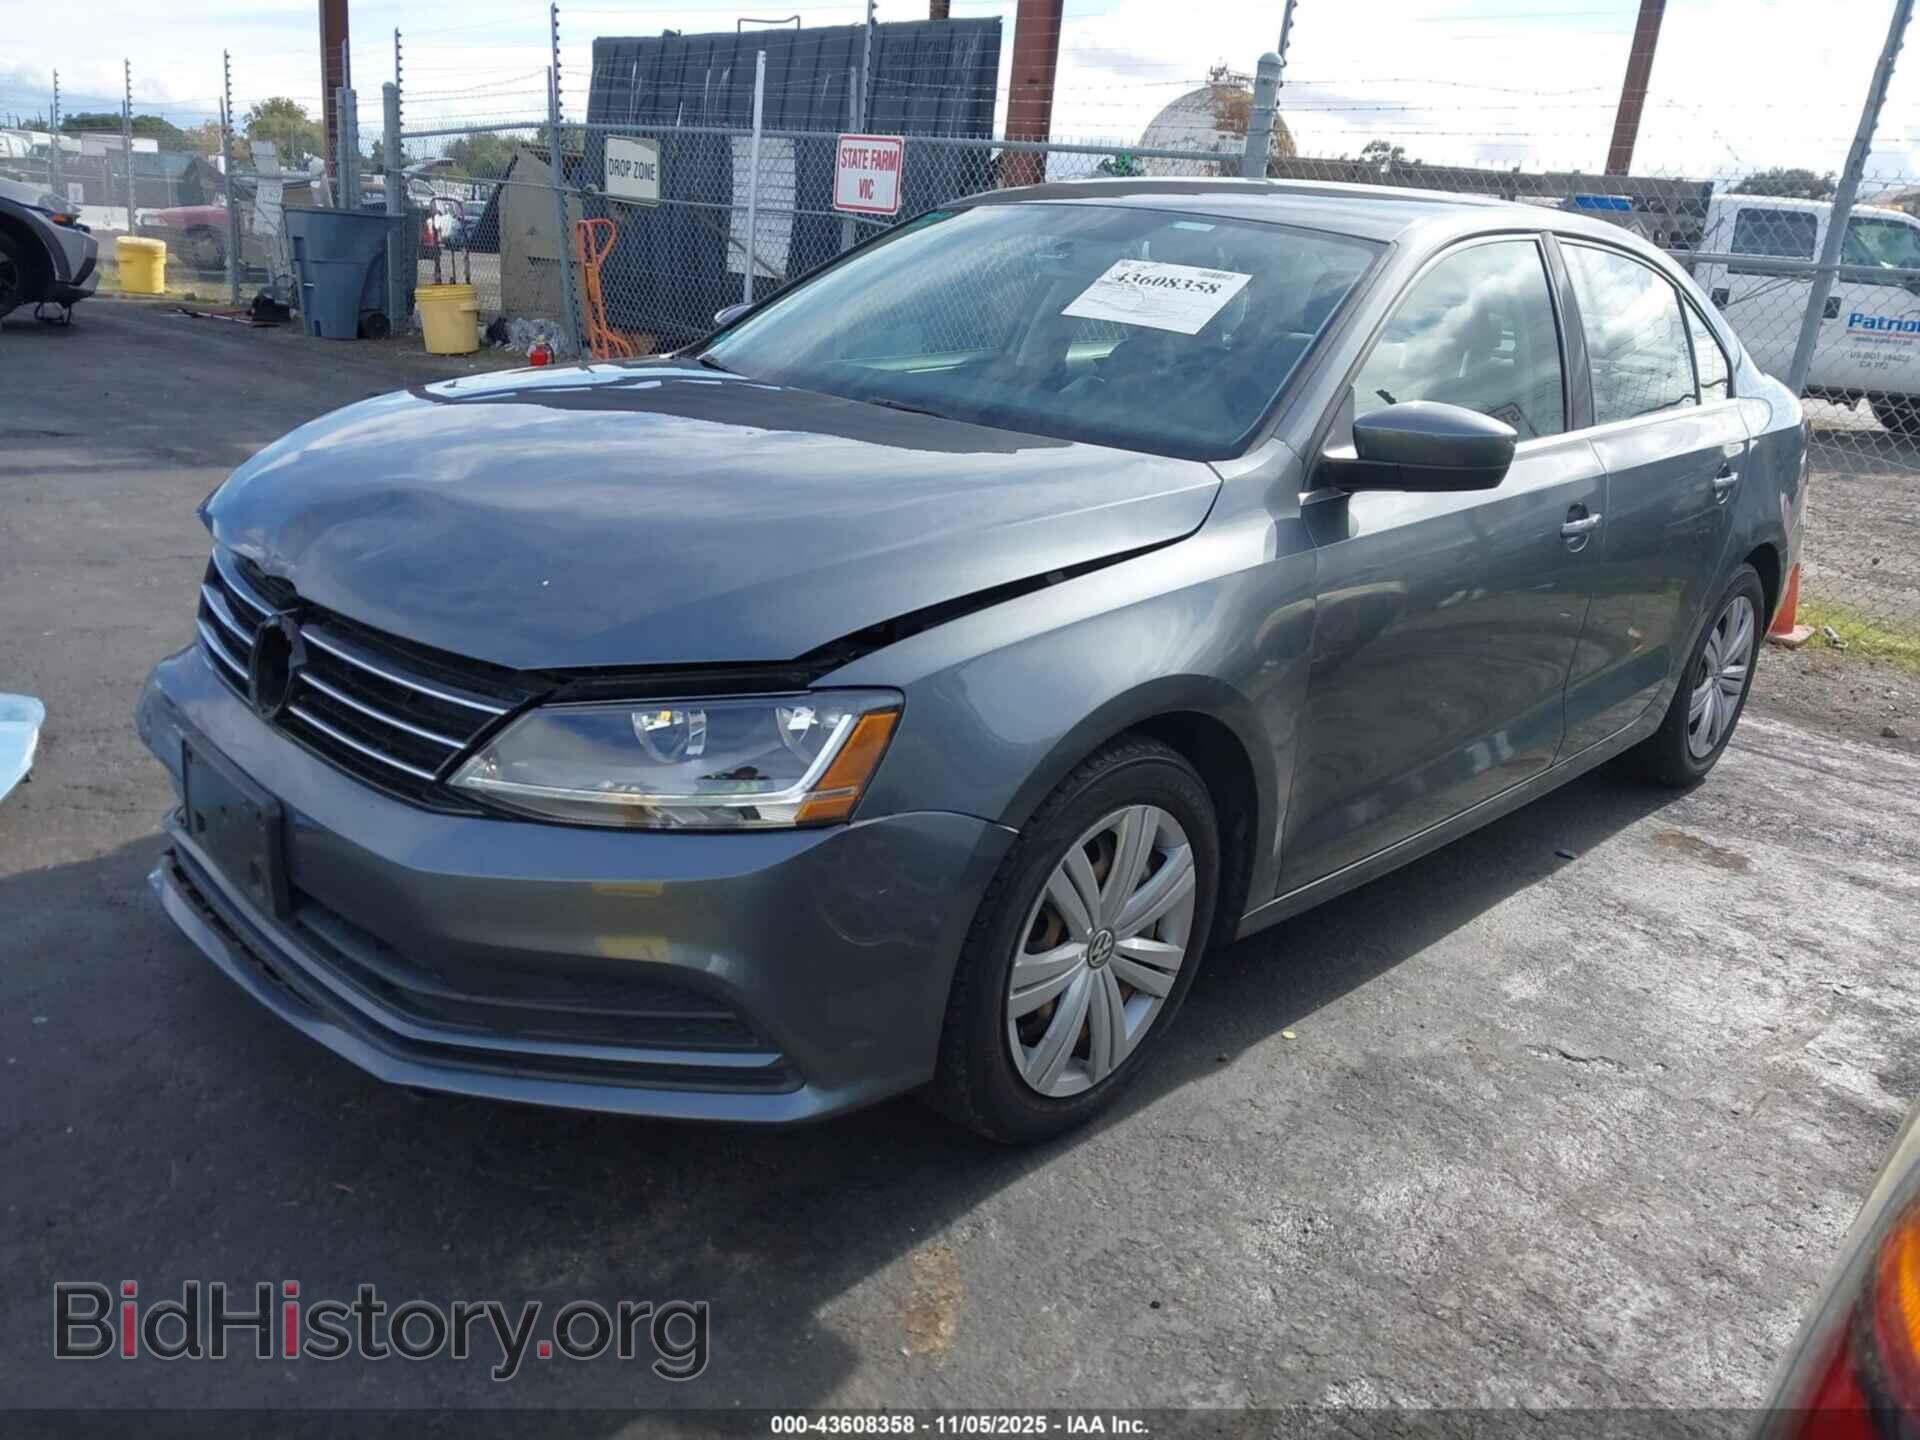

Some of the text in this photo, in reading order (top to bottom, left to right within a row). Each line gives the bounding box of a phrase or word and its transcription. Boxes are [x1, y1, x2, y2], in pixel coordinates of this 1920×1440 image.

[608, 158, 656, 181] DROP ZONE
[841, 147, 898, 171] STATE FARM
[858, 178, 874, 200] VIC
[1116, 271, 1222, 295] 43608358
